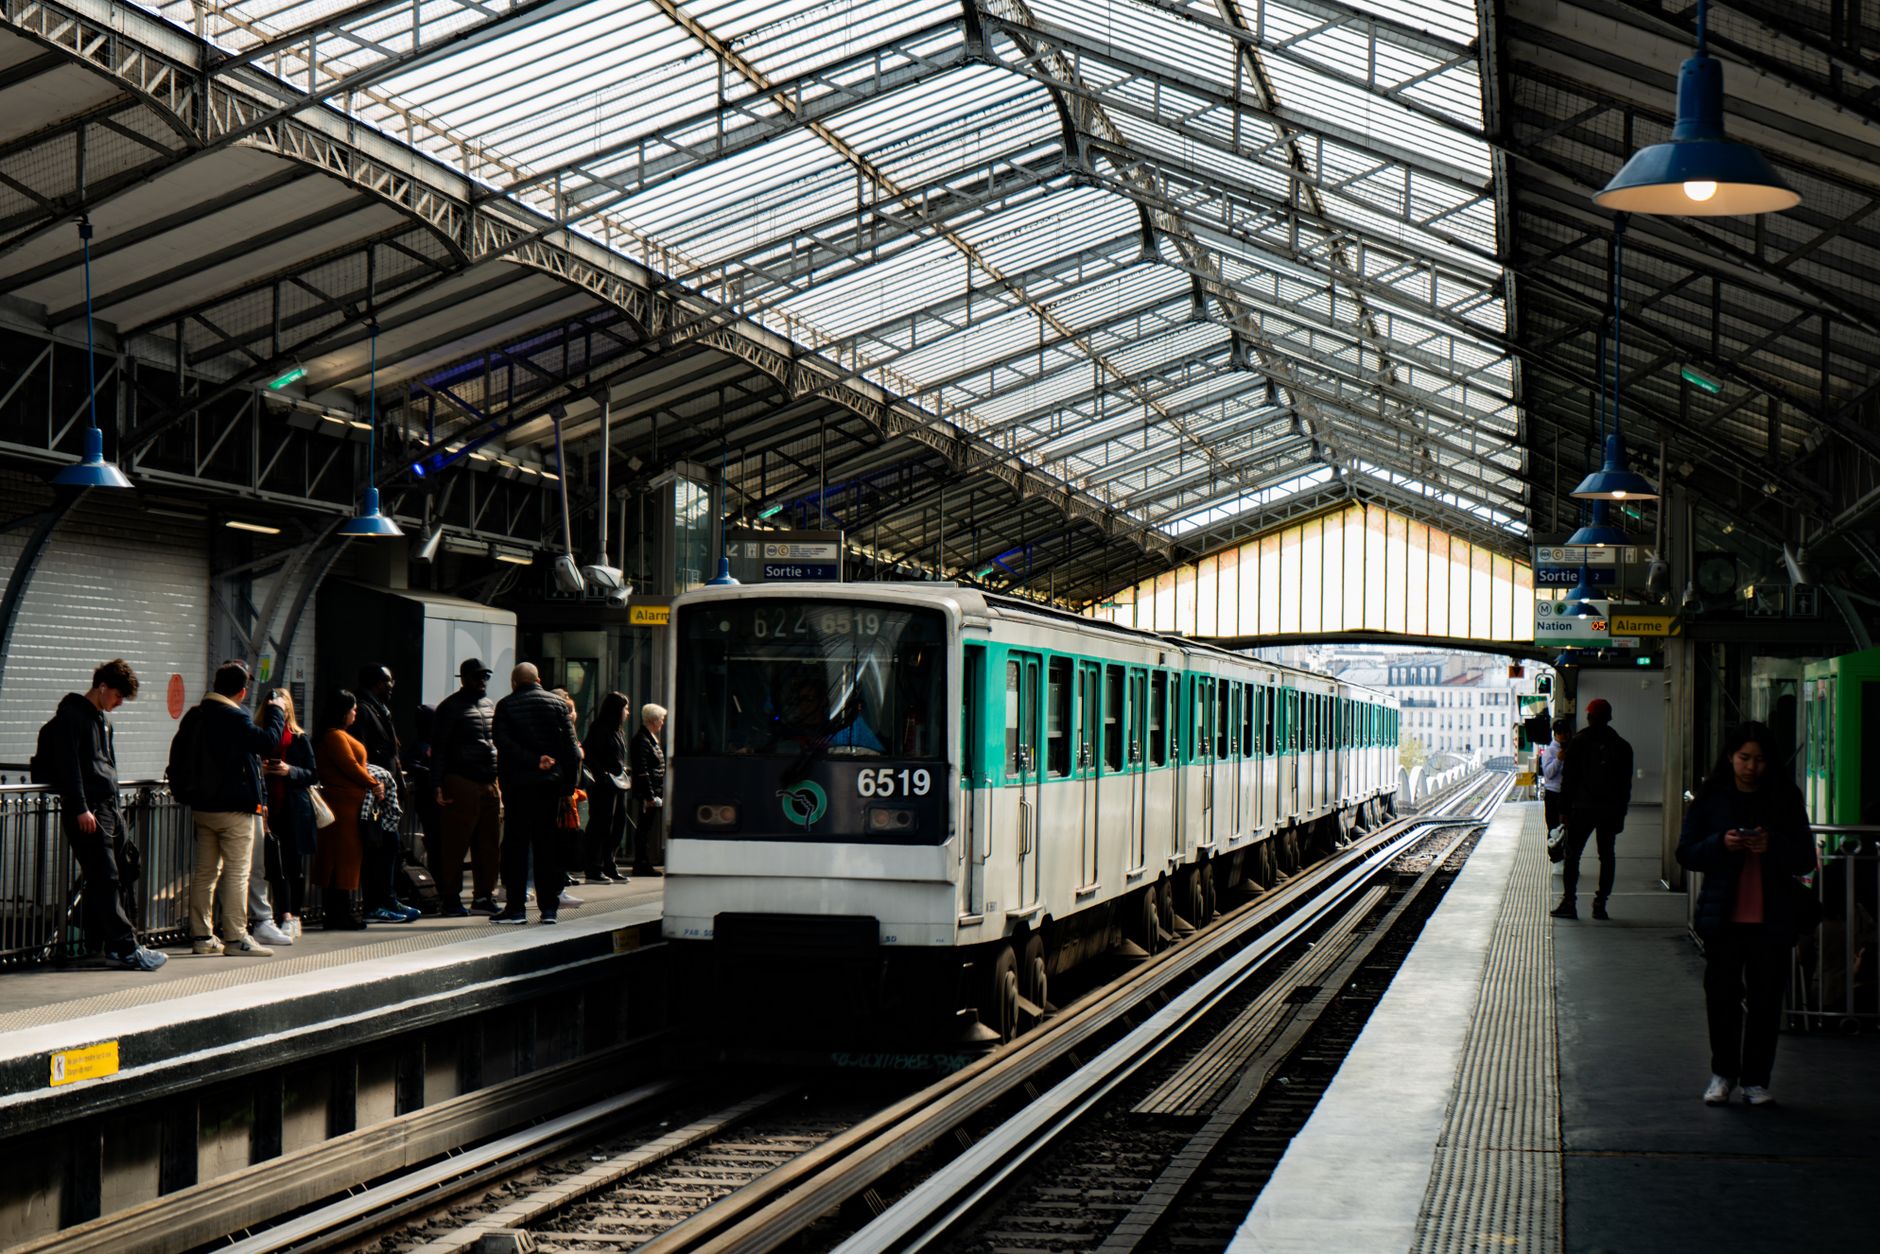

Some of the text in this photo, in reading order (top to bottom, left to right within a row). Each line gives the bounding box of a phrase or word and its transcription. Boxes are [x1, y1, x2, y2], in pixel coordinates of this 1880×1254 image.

[765, 565, 802, 577] Sortie
[1538, 570, 1578, 582] Sortie
[636, 609, 670, 621] Alarm
[821, 613, 880, 636] 6519
[1537, 621, 1572, 631] Nation
[1591, 620, 1606, 631] 05
[1616, 620, 1663, 632] Alarme
[857, 768, 931, 797] 6519
